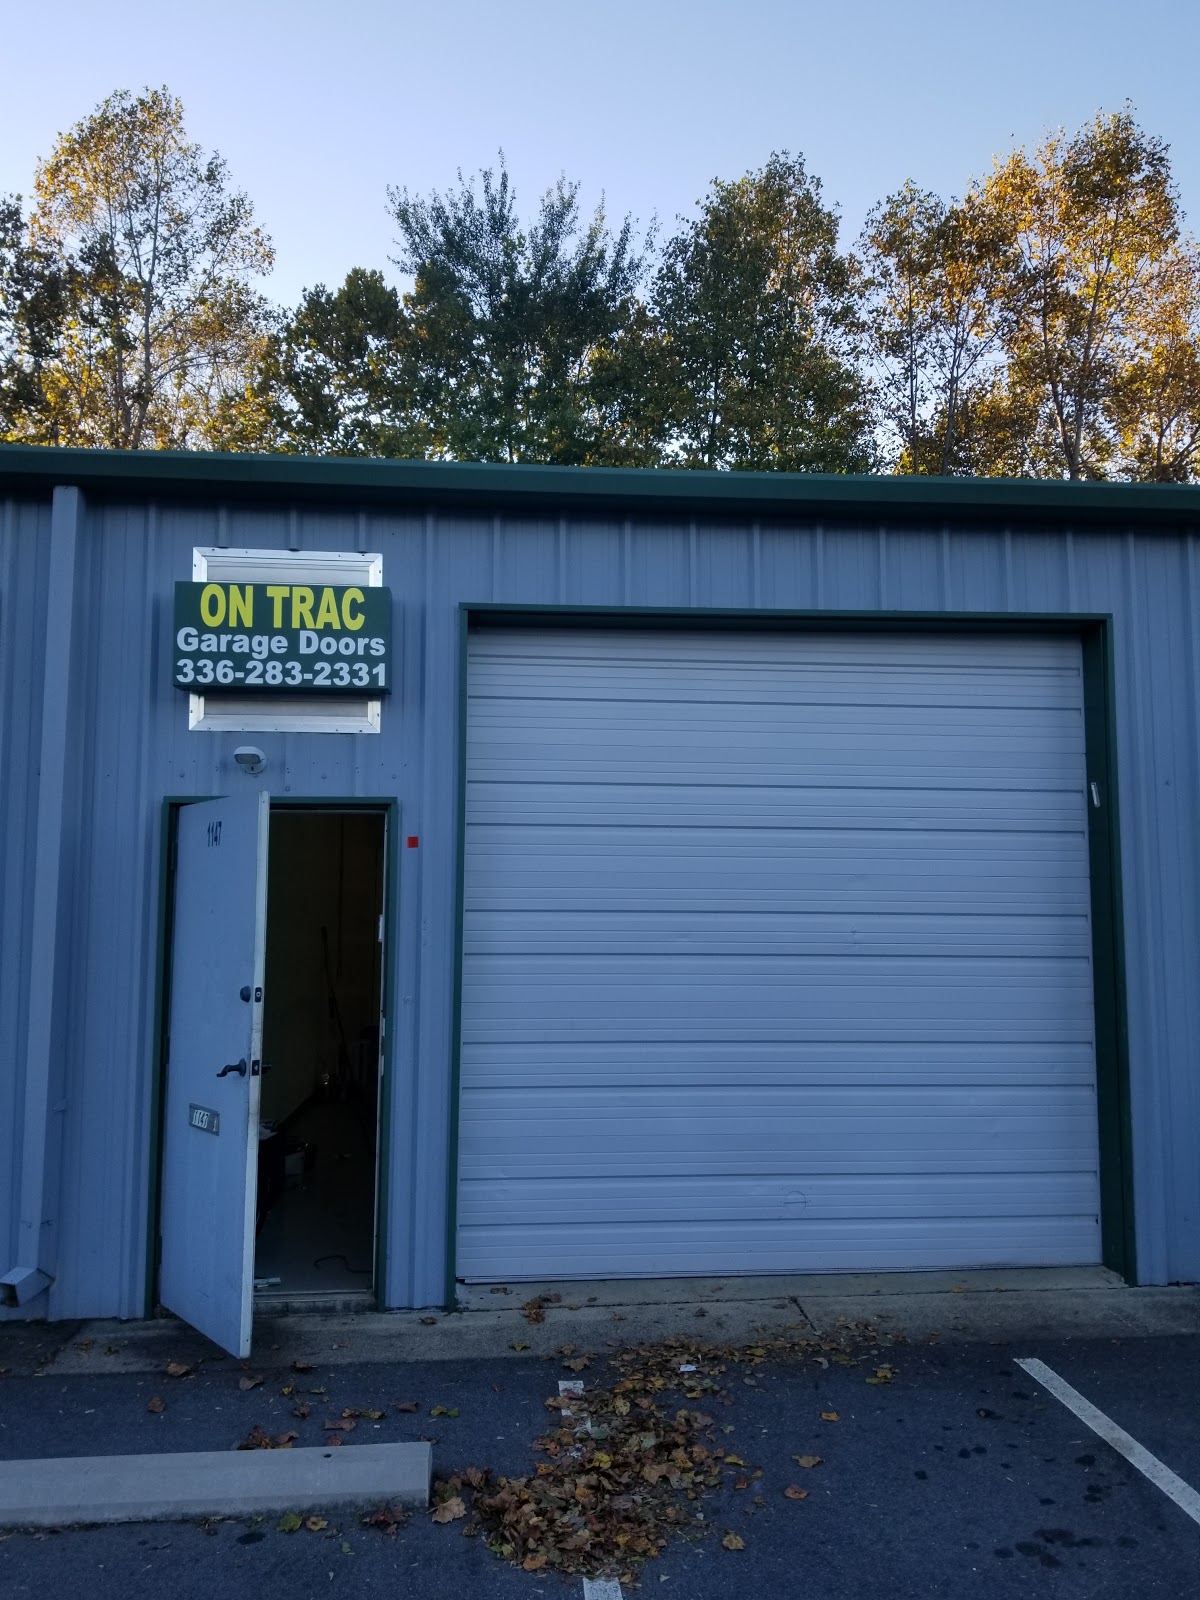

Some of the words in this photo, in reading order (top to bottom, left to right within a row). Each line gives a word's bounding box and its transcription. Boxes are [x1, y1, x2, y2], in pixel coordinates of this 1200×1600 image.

[200, 583, 254, 628] ON
[266, 586, 366, 630] TRAC
[176, 627, 288, 660] Garage
[299, 630, 386, 656] Doors
[176, 659, 386, 687] 336-283-2331
